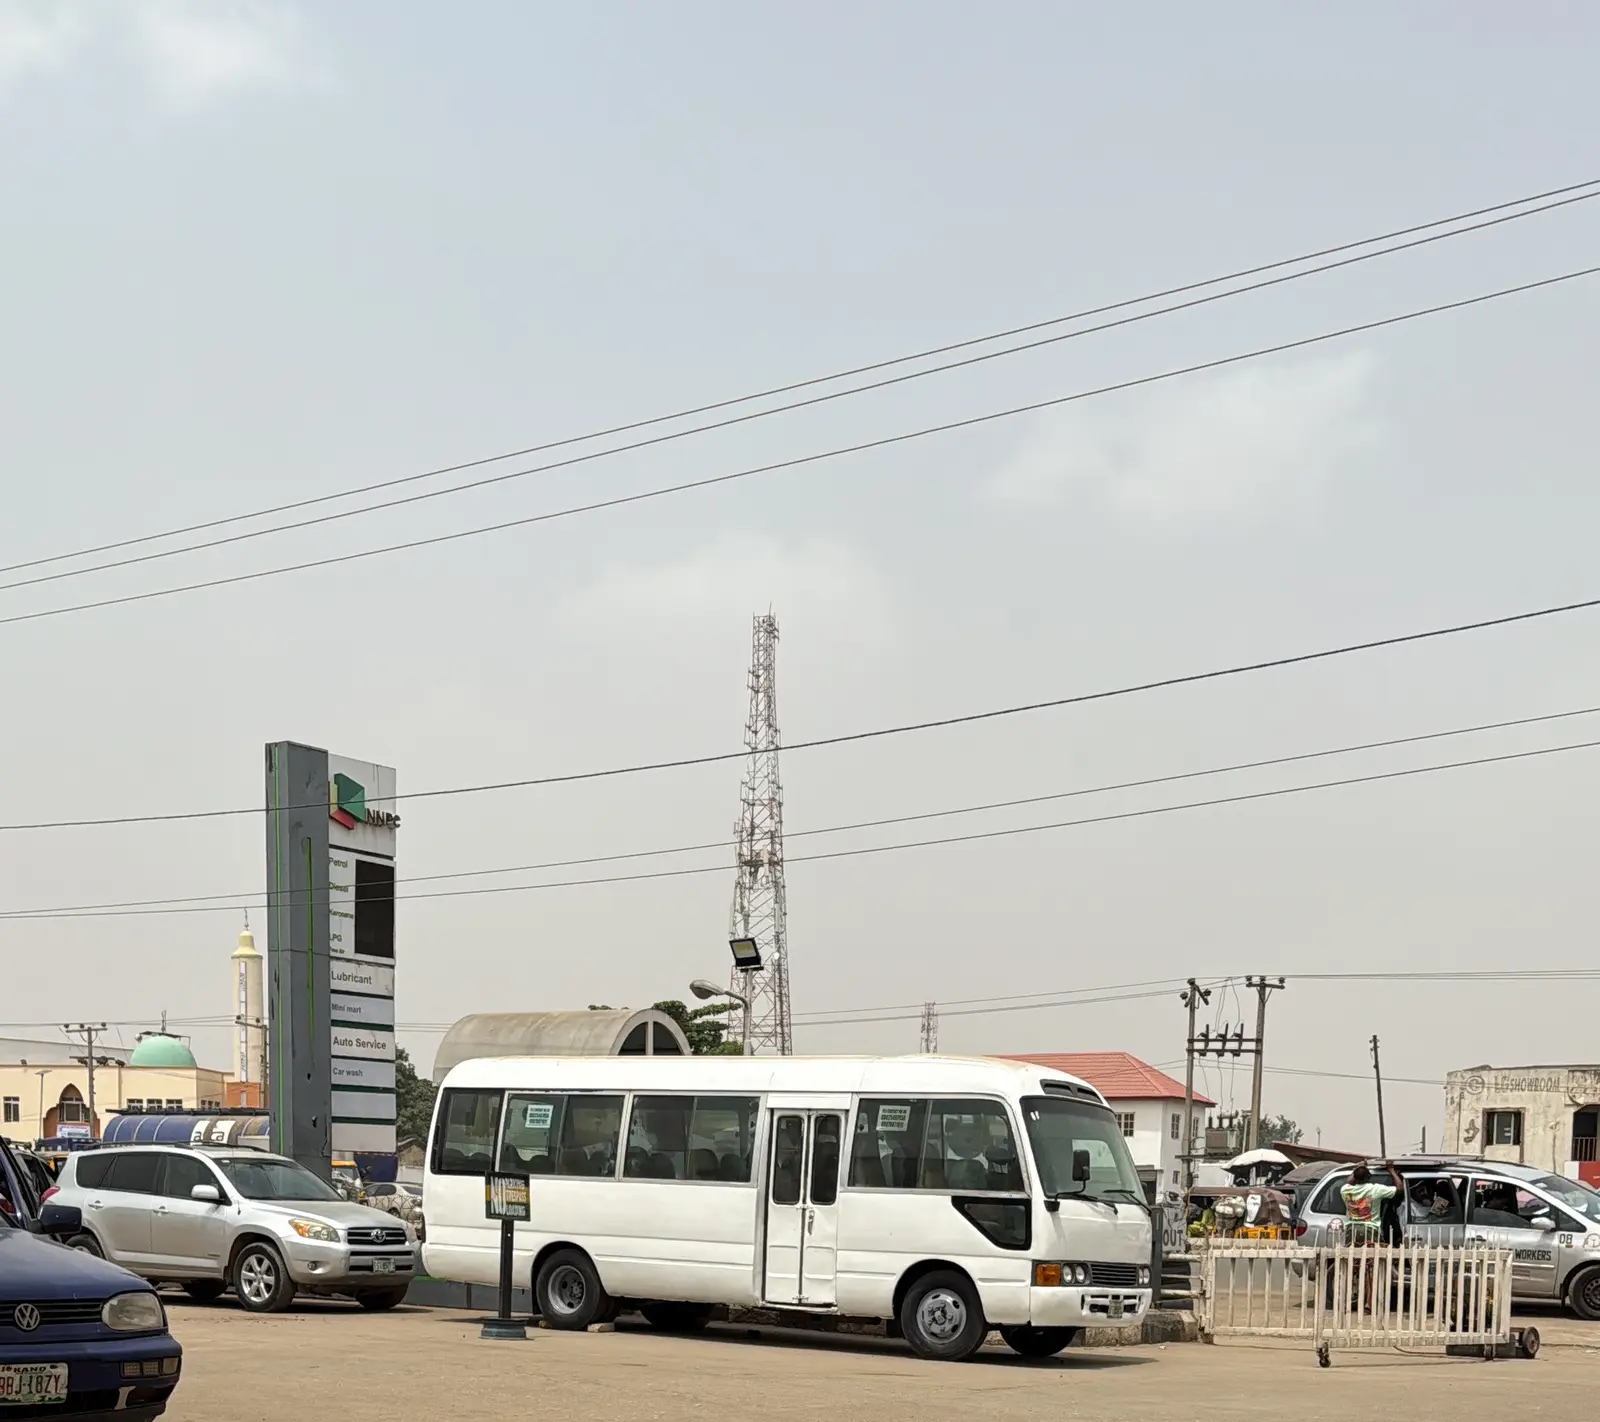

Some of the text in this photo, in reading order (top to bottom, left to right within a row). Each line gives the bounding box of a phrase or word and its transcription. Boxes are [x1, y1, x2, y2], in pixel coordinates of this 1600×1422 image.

[328, 856, 348, 869] Petrol
[331, 970, 373, 985] Lubricant
[331, 1002, 346, 1012] Mini
[333, 1036, 387, 1050] Auto Service
[332, 1067, 363, 1077] Car wash
[1163, 1228, 1183, 1246] OUT
[1559, 1233, 1573, 1244] 08
[1515, 1249, 1552, 1261] WORKERS
